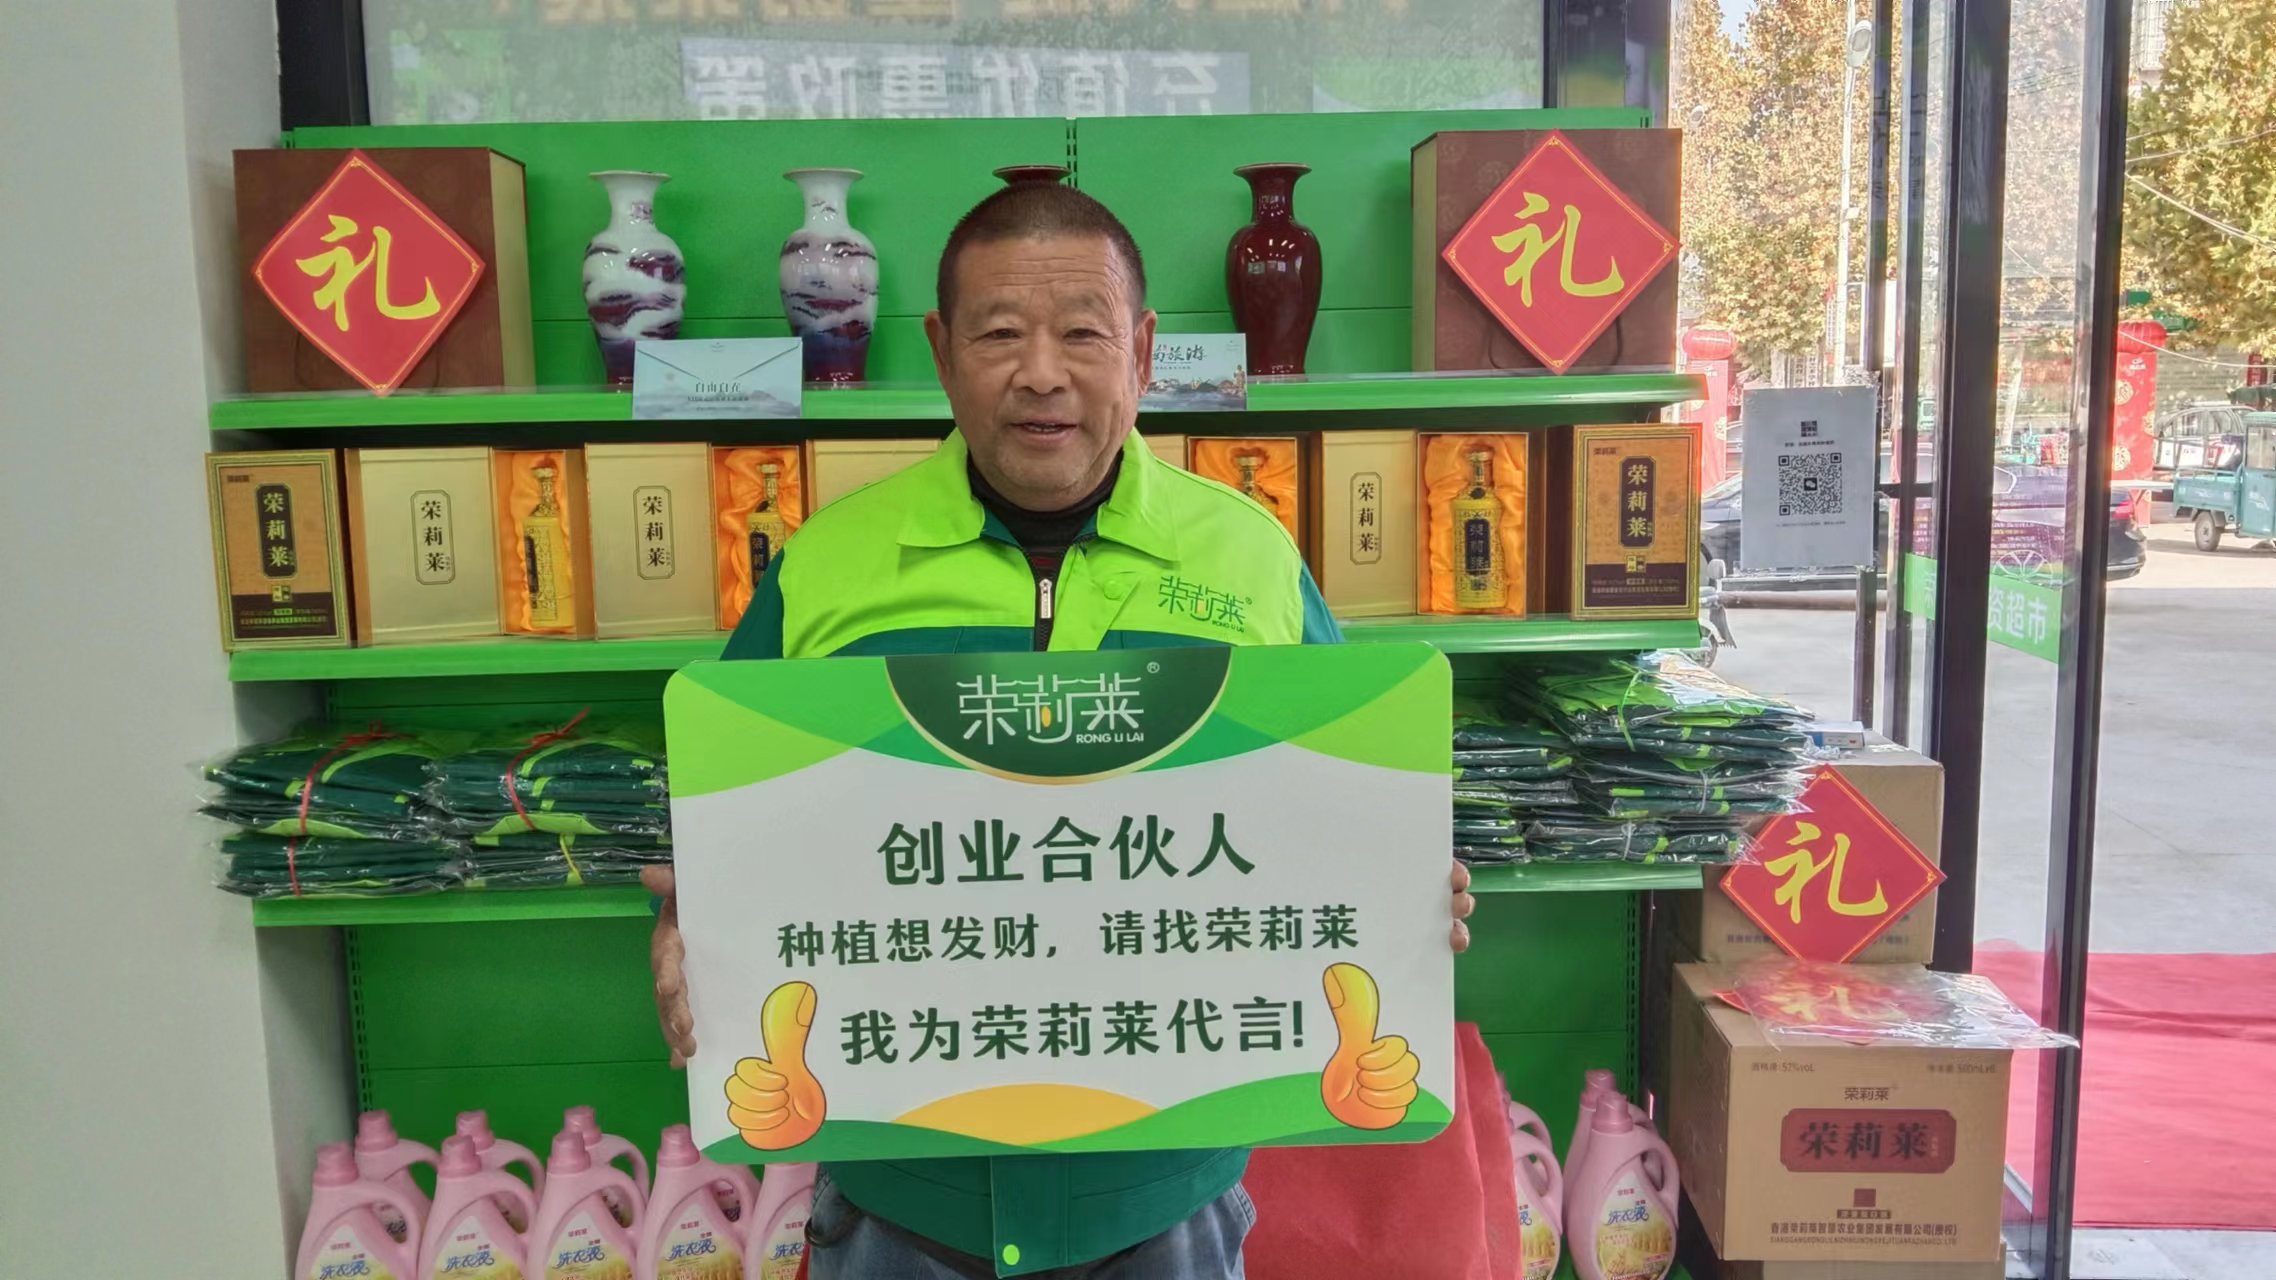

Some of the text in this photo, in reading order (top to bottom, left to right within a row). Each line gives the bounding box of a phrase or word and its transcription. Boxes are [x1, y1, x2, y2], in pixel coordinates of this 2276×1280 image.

[295, 214, 441, 332] 礼
[1491, 191, 1625, 308] 礼
[263, 492, 288, 567] 荣莉莱
[420, 500, 445, 572] 荣莉莱
[642, 495, 666, 567] 荣莉莱
[1357, 482, 1375, 552] 荣莉莱
[1627, 464, 1649, 537] 荣莉莱
[1158, 575, 1246, 625] 荣莉莱
[956, 672, 1145, 745] 荣莉莱
[1076, 732, 1144, 744] RONG LI LAI
[876, 813, 1256, 886] 创业合伙人
[1763, 820, 1889, 924] 礼
[840, 994, 1305, 1066] 我为荣莉莱代言!
[1844, 1086, 1890, 1101] 荣莉莱
[1798, 1121, 1929, 1160] 荣莉莱
[441, 1250, 495, 1274] 洗衣液
[552, 1246, 605, 1269] 洗衣液
[665, 1238, 717, 1262] 洗衣液
